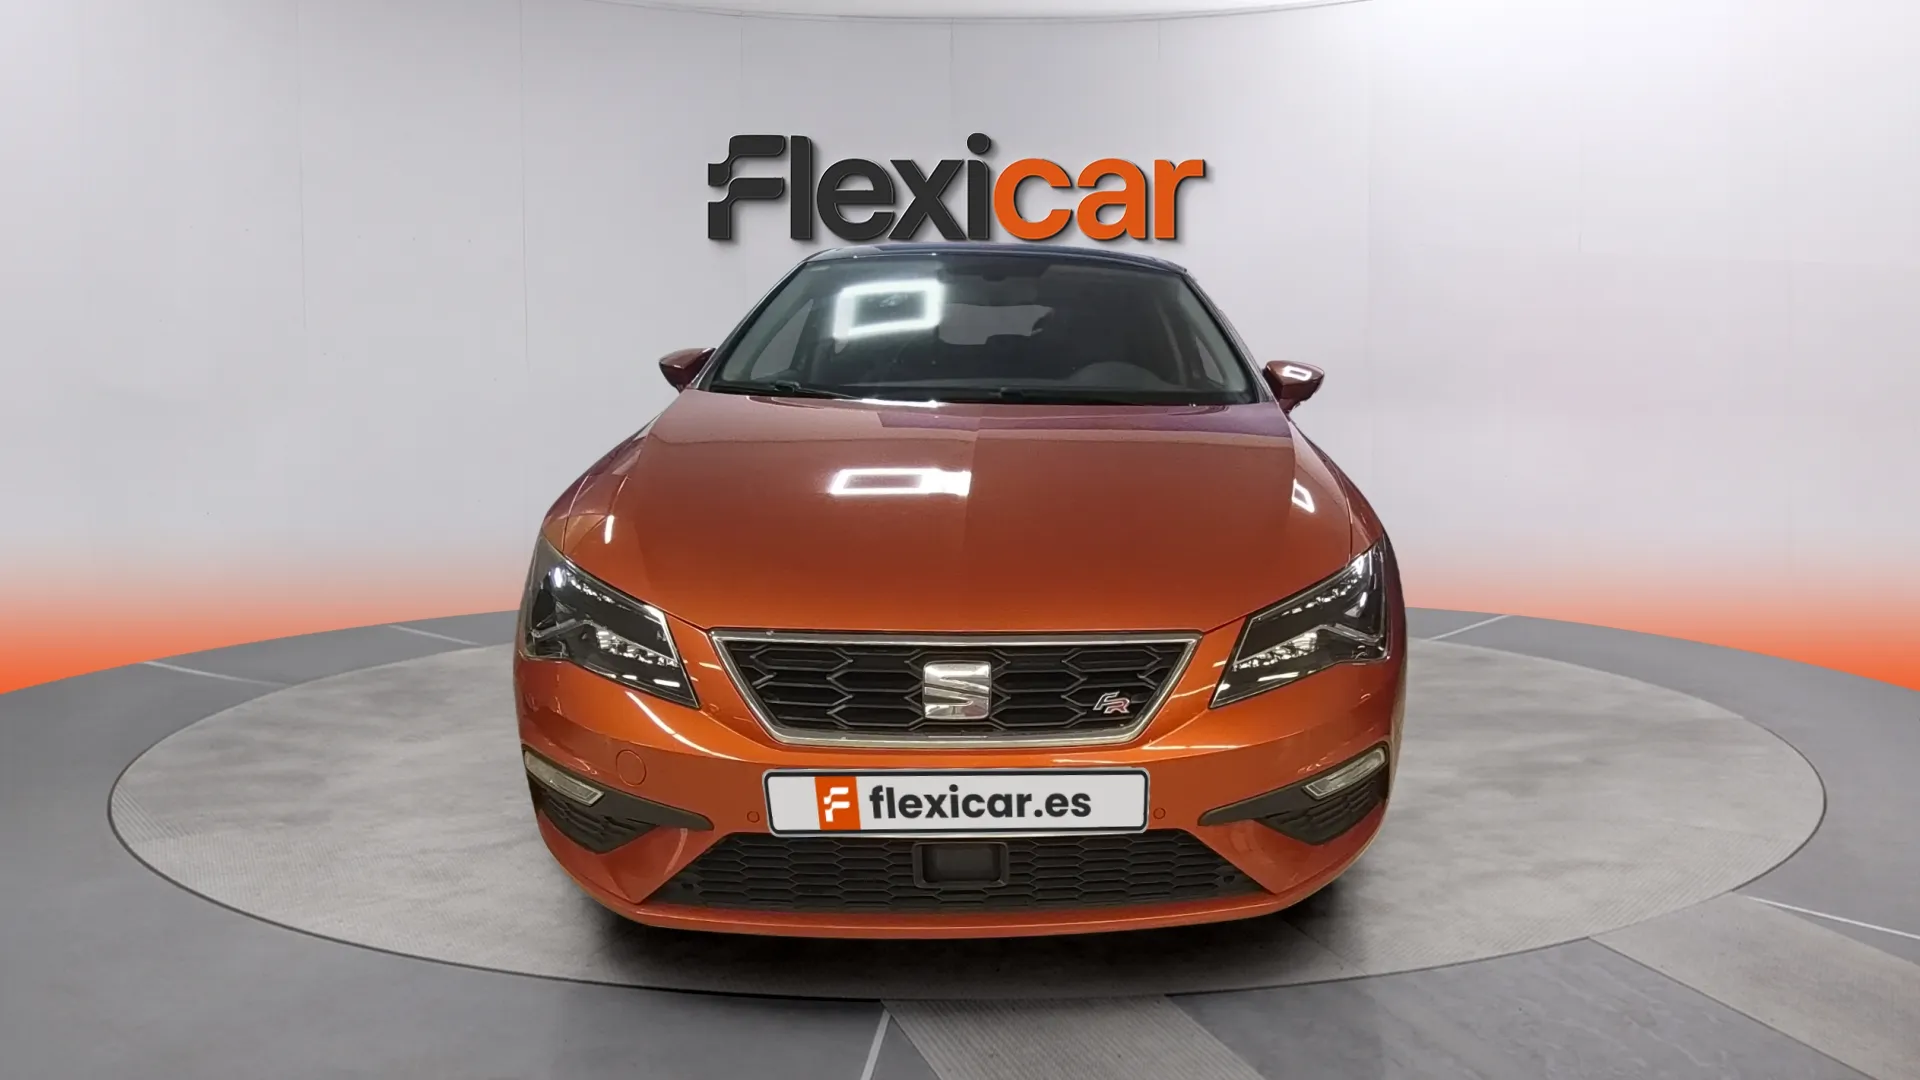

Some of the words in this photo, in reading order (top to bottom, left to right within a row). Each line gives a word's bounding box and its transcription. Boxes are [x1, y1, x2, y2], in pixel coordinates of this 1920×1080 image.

[707, 132, 1205, 241] Flexicar
[1092, 690, 1130, 714] FR
[869, 784, 1092, 820] flexicar.es
